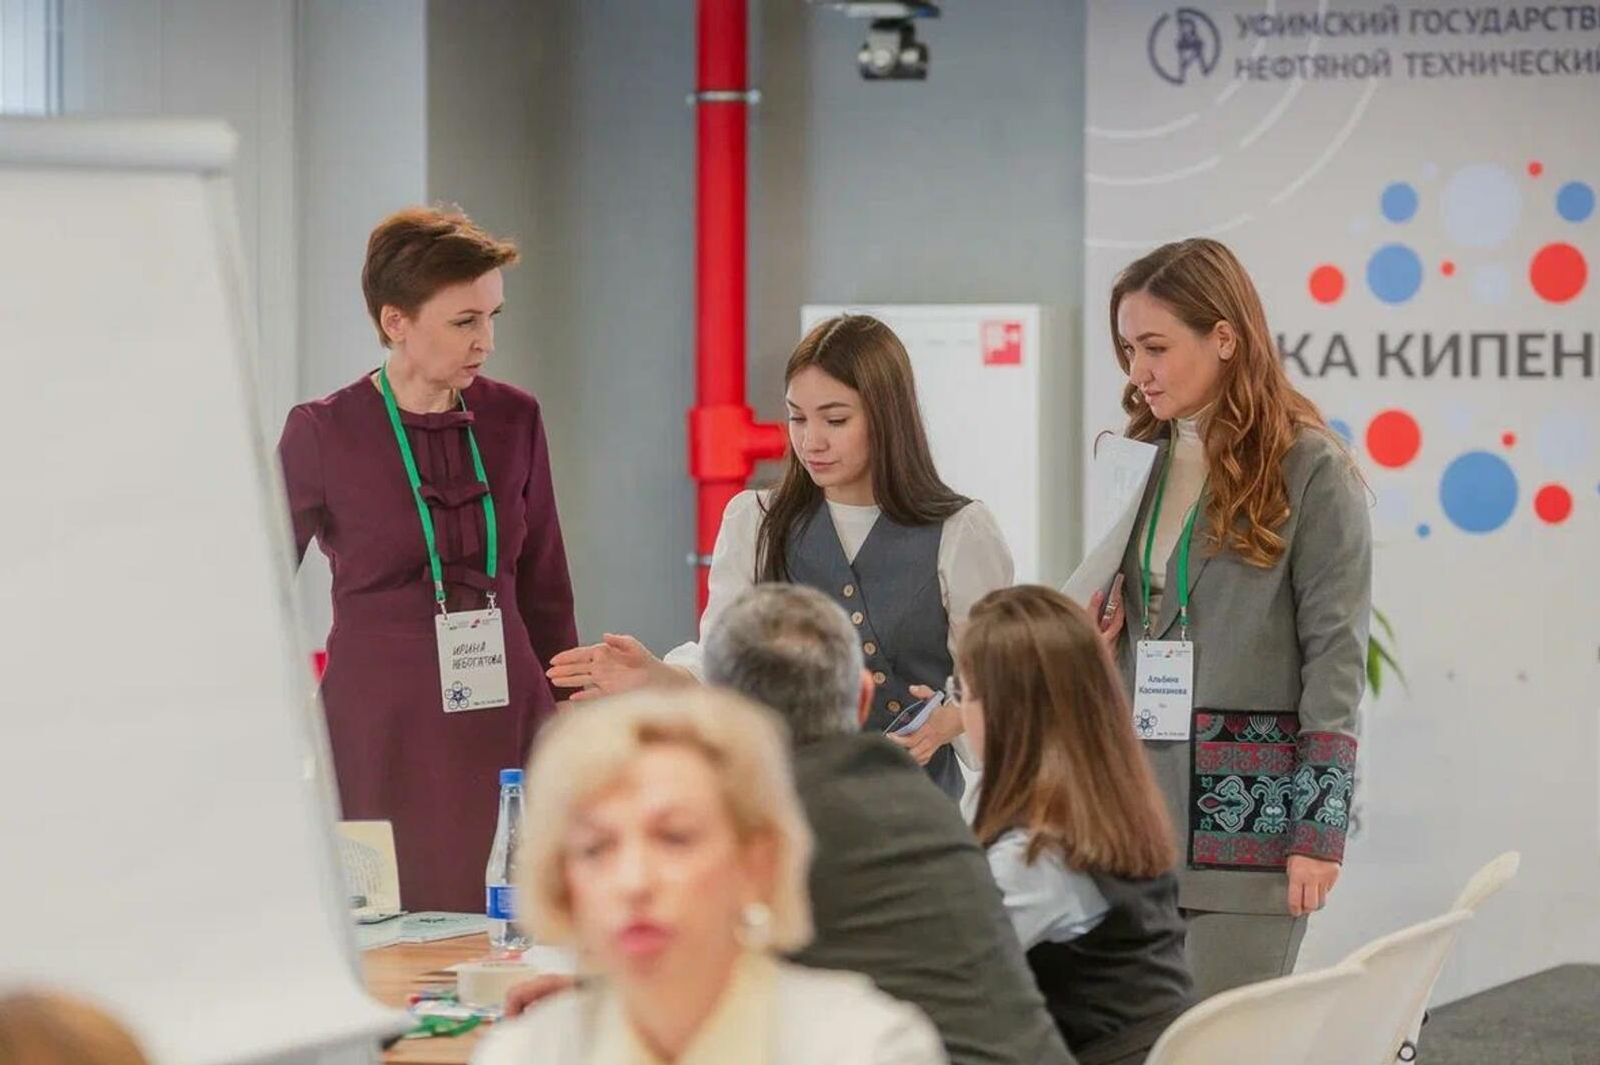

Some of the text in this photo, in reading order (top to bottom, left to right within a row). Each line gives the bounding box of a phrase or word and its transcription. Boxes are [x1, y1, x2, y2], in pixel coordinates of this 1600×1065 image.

[1234, 4, 1600, 38] УФИМСКИЙ ГОСУДАРСТВ
[1234, 48, 1600, 80] НЕФТЯНОЙ ТЕХНИЧЕСКИ
[1376, 332, 1600, 378] КИПЕН
